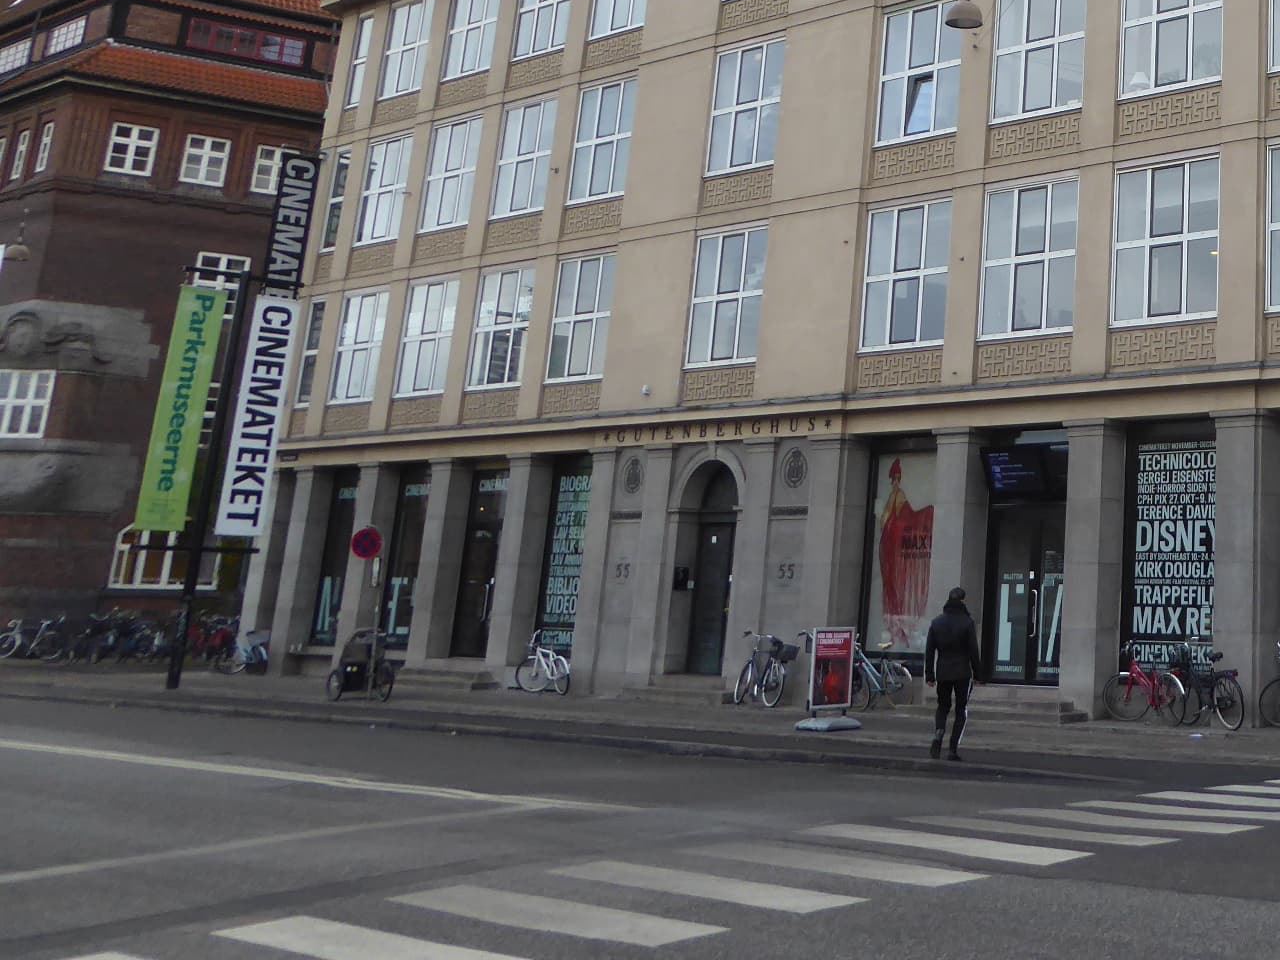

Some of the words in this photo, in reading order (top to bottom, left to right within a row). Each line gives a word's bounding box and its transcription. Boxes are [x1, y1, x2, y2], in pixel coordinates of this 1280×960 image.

[157, 294, 215, 492] Parkmuseerne
[227, 305, 292, 527] CINEMATEKET
[616, 416, 816, 443] GUTENBERGHUS
[1138, 451, 1217, 471] TECHNICOLO
[1137, 471, 1170, 485] SERGEJ
[1186, 483, 1208, 493] SIDEN
[1137, 494, 1153, 505] CPH
[1154, 494, 1168, 505] PIX
[1137, 505, 1184, 520] TERENCE
[1136, 520, 1216, 552] DISNEY
[1135, 552, 1149, 561] EAST
[615, 563, 631, 579] 55
[778, 563, 796, 580] 55
[1135, 561, 1164, 578] KIRK
[1164, 561, 1215, 578] DOUGLA
[547, 576, 580, 594] BIBLIO
[545, 595, 577, 614] VIDEO
[1133, 606, 1182, 635] MAX
